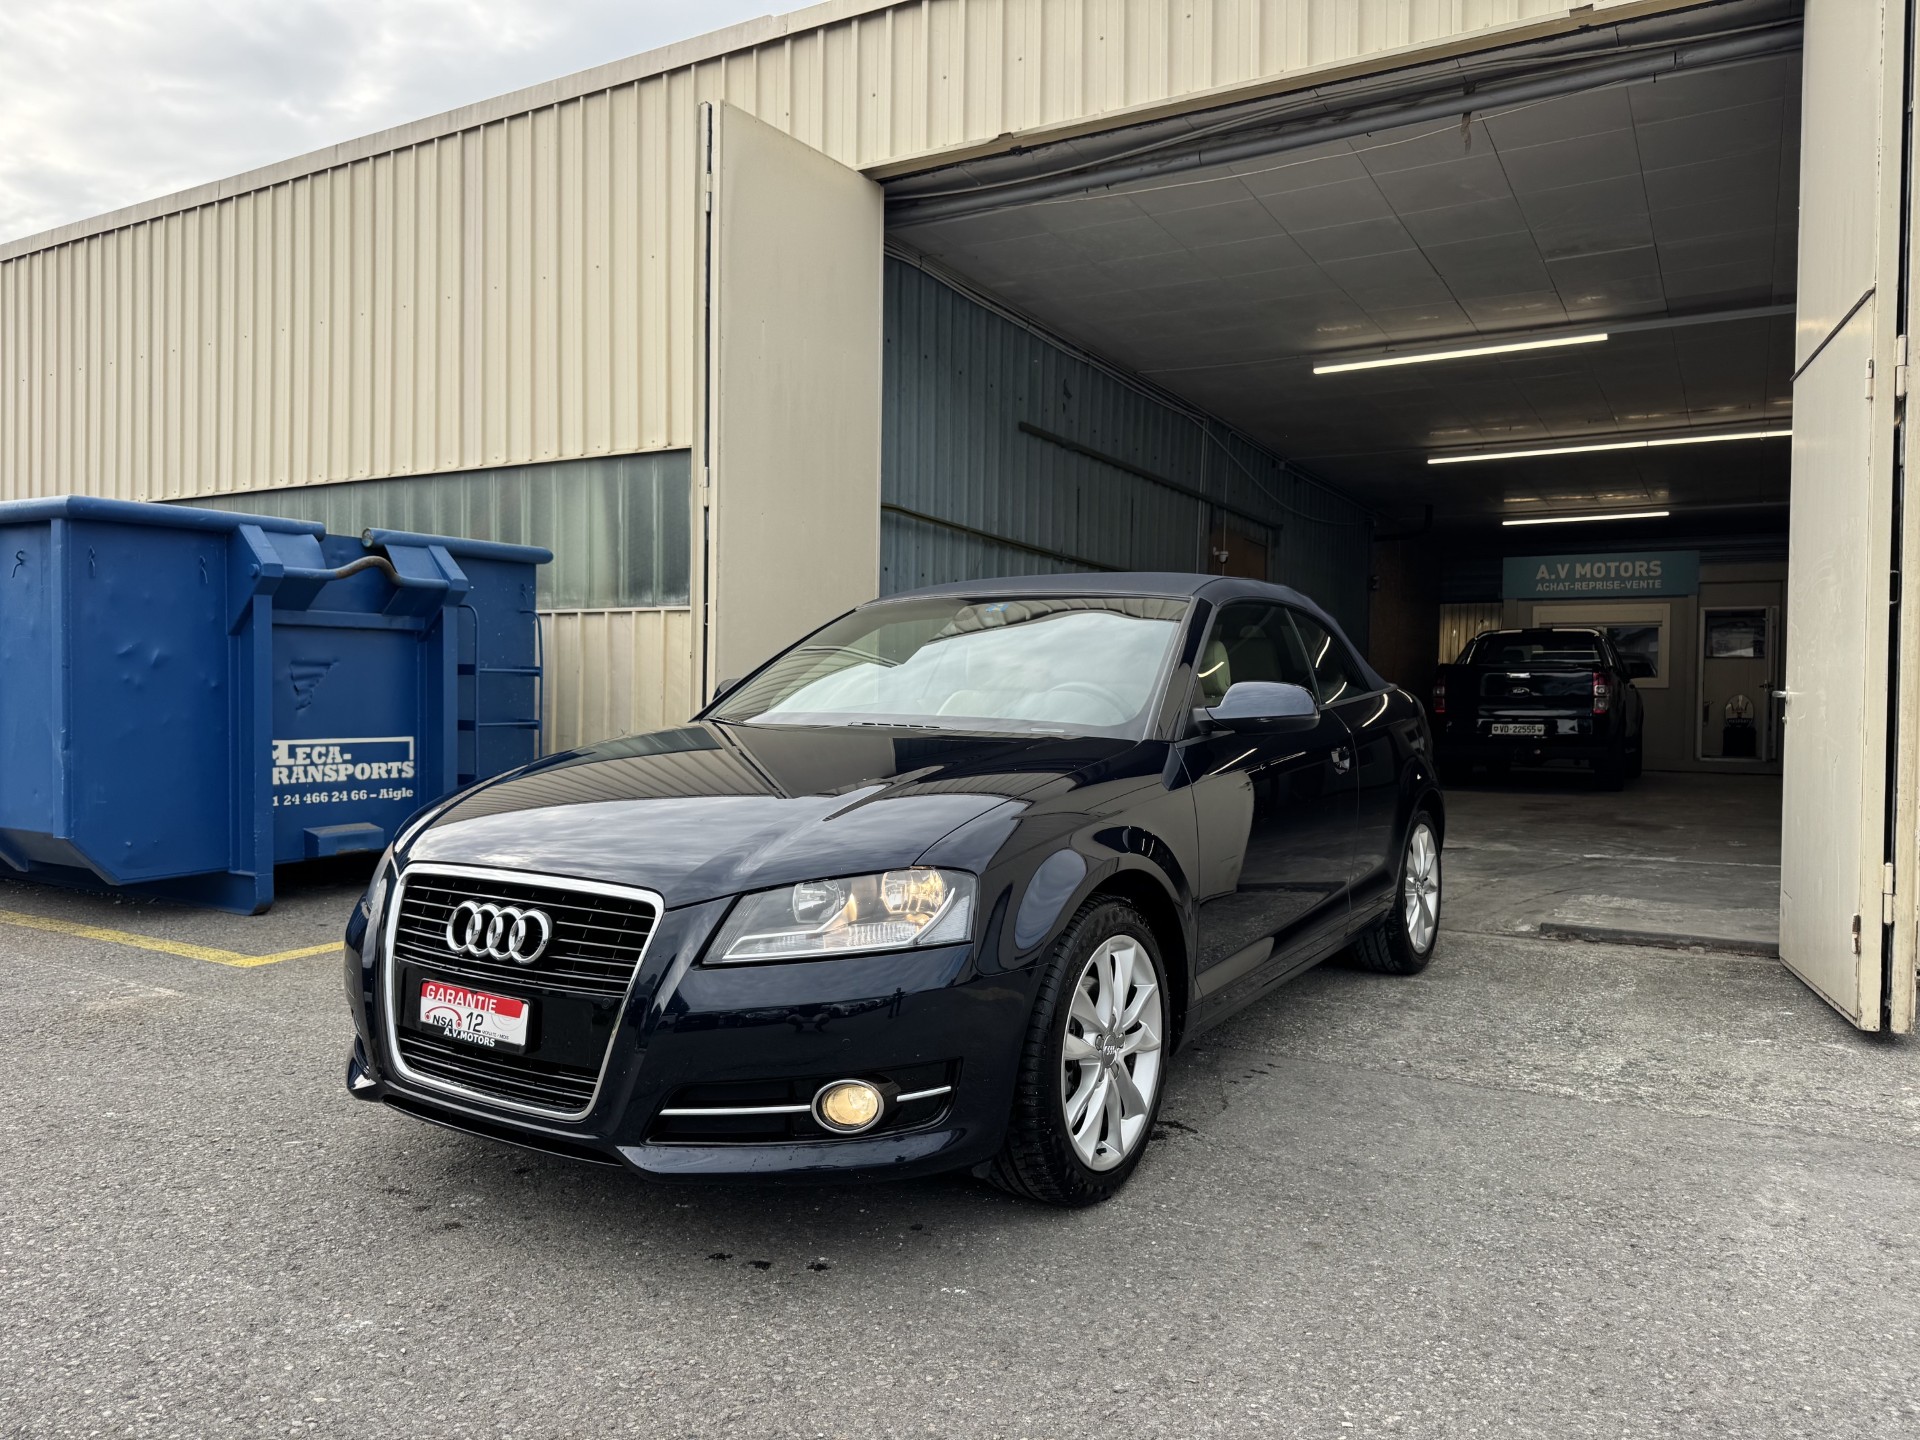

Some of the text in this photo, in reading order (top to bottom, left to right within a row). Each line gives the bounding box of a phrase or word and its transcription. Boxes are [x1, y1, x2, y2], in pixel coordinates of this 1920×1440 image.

[1536, 561, 1662, 579] A.V MOTORS
[1536, 580, 1662, 591] ACHAT-REPRISE-VENTE
[272, 761, 415, 785] RANSPORTS
[283, 794, 300, 806] 24
[303, 792, 329, 804] 466
[331, 791, 348, 802] 24
[351, 790, 367, 800] 66
[379, 787, 413, 800] Aigle
[426, 985, 497, 1014] GARANTIE
[432, 1014, 453, 1029] NSA
[466, 1011, 484, 1033] 12
